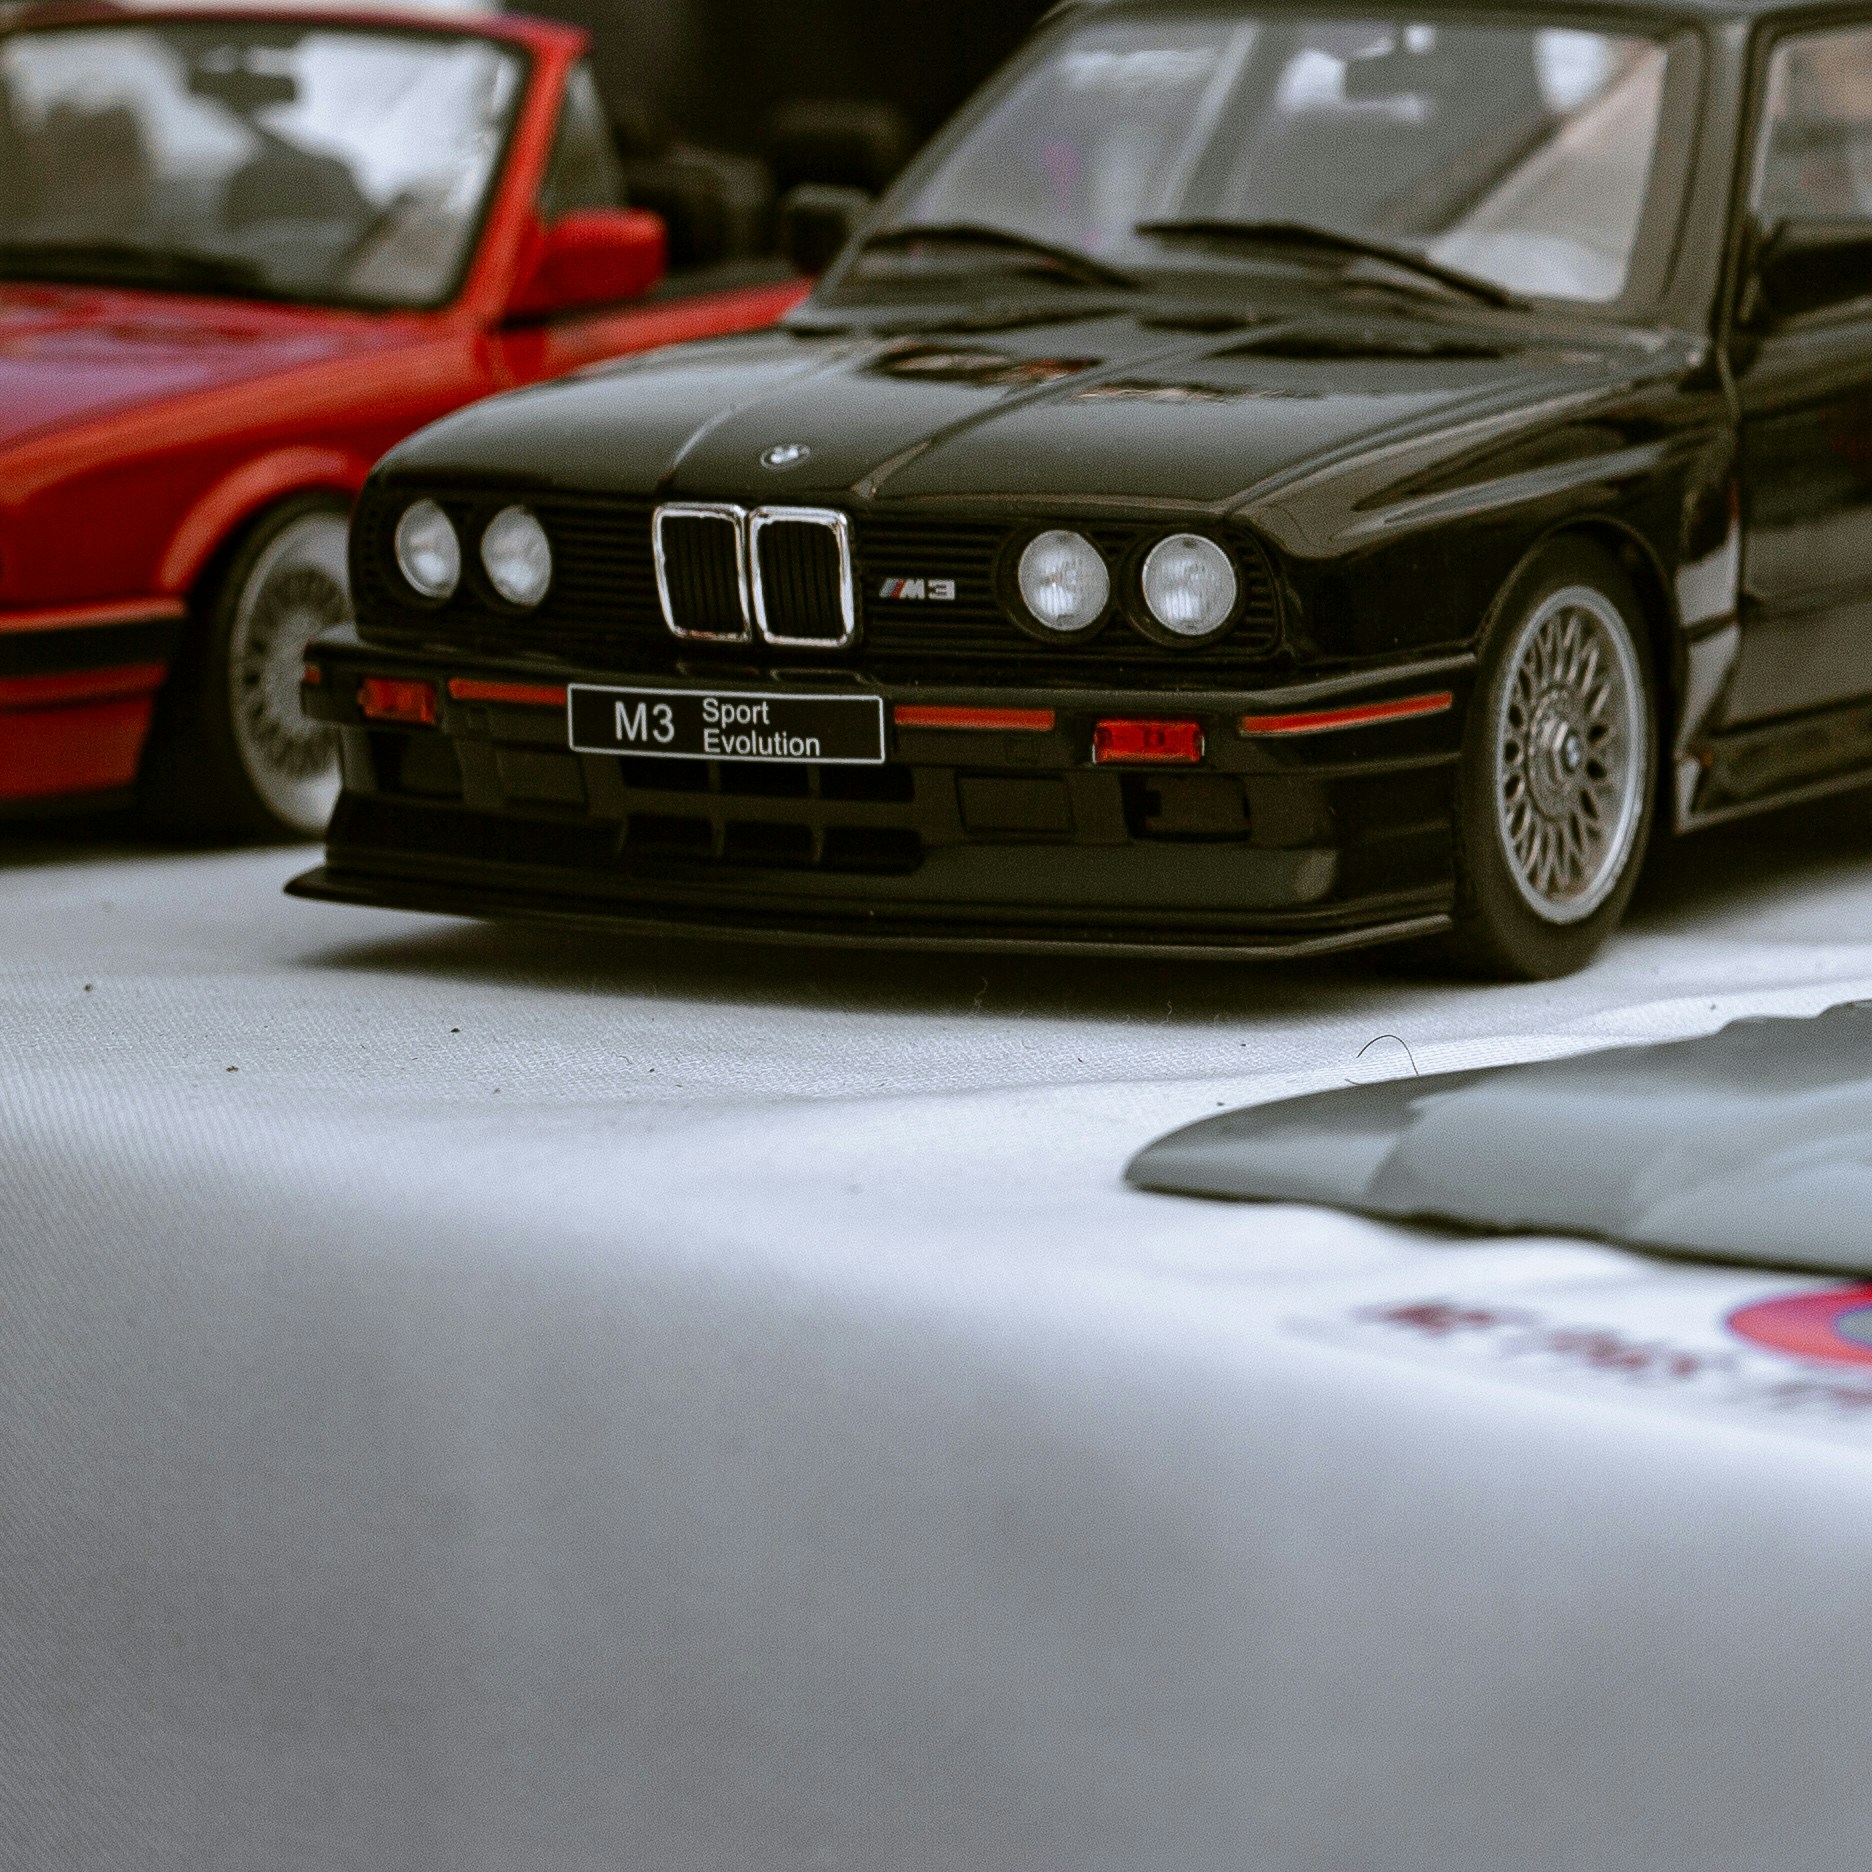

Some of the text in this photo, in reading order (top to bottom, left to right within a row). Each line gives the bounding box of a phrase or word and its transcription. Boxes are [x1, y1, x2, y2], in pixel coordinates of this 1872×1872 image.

[614, 700, 675, 744] M3
[702, 697, 770, 729] Sport
[702, 727, 821, 757] Evolution
